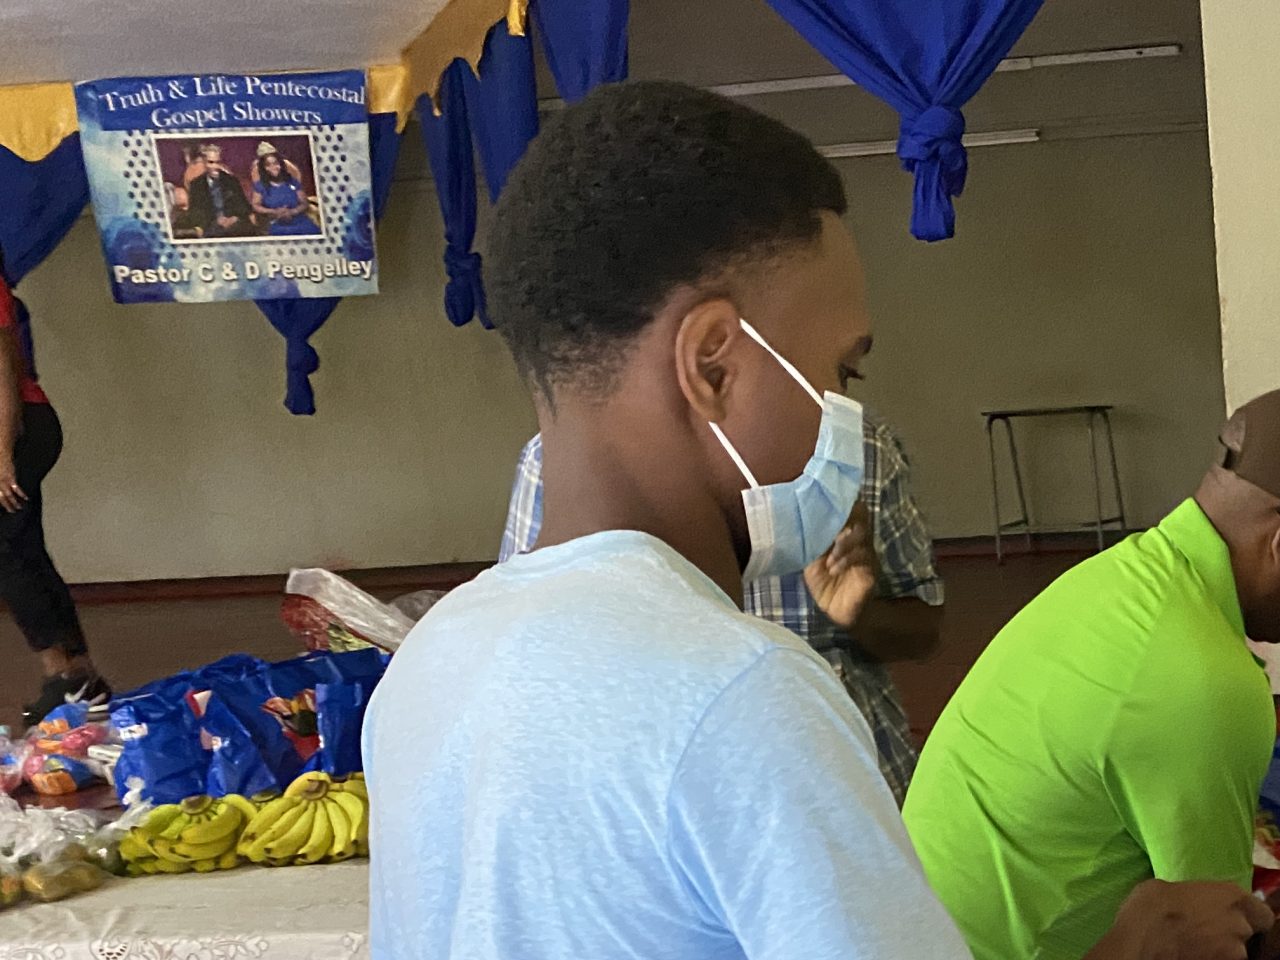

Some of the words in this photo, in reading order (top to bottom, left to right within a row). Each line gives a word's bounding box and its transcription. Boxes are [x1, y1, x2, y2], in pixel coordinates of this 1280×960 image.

[98, 83, 164, 112] Truth
[168, 79, 188, 99] &
[194, 76, 239, 97] Life
[245, 76, 367, 105] Pentecostal
[151, 102, 228, 128] Gospel
[233, 101, 322, 124] Showers
[114, 264, 191, 284] Pastor
[199, 263, 214, 281] C
[221, 262, 239, 281] &
[245, 261, 261, 279] D
[267, 258, 374, 283] Pengelley
